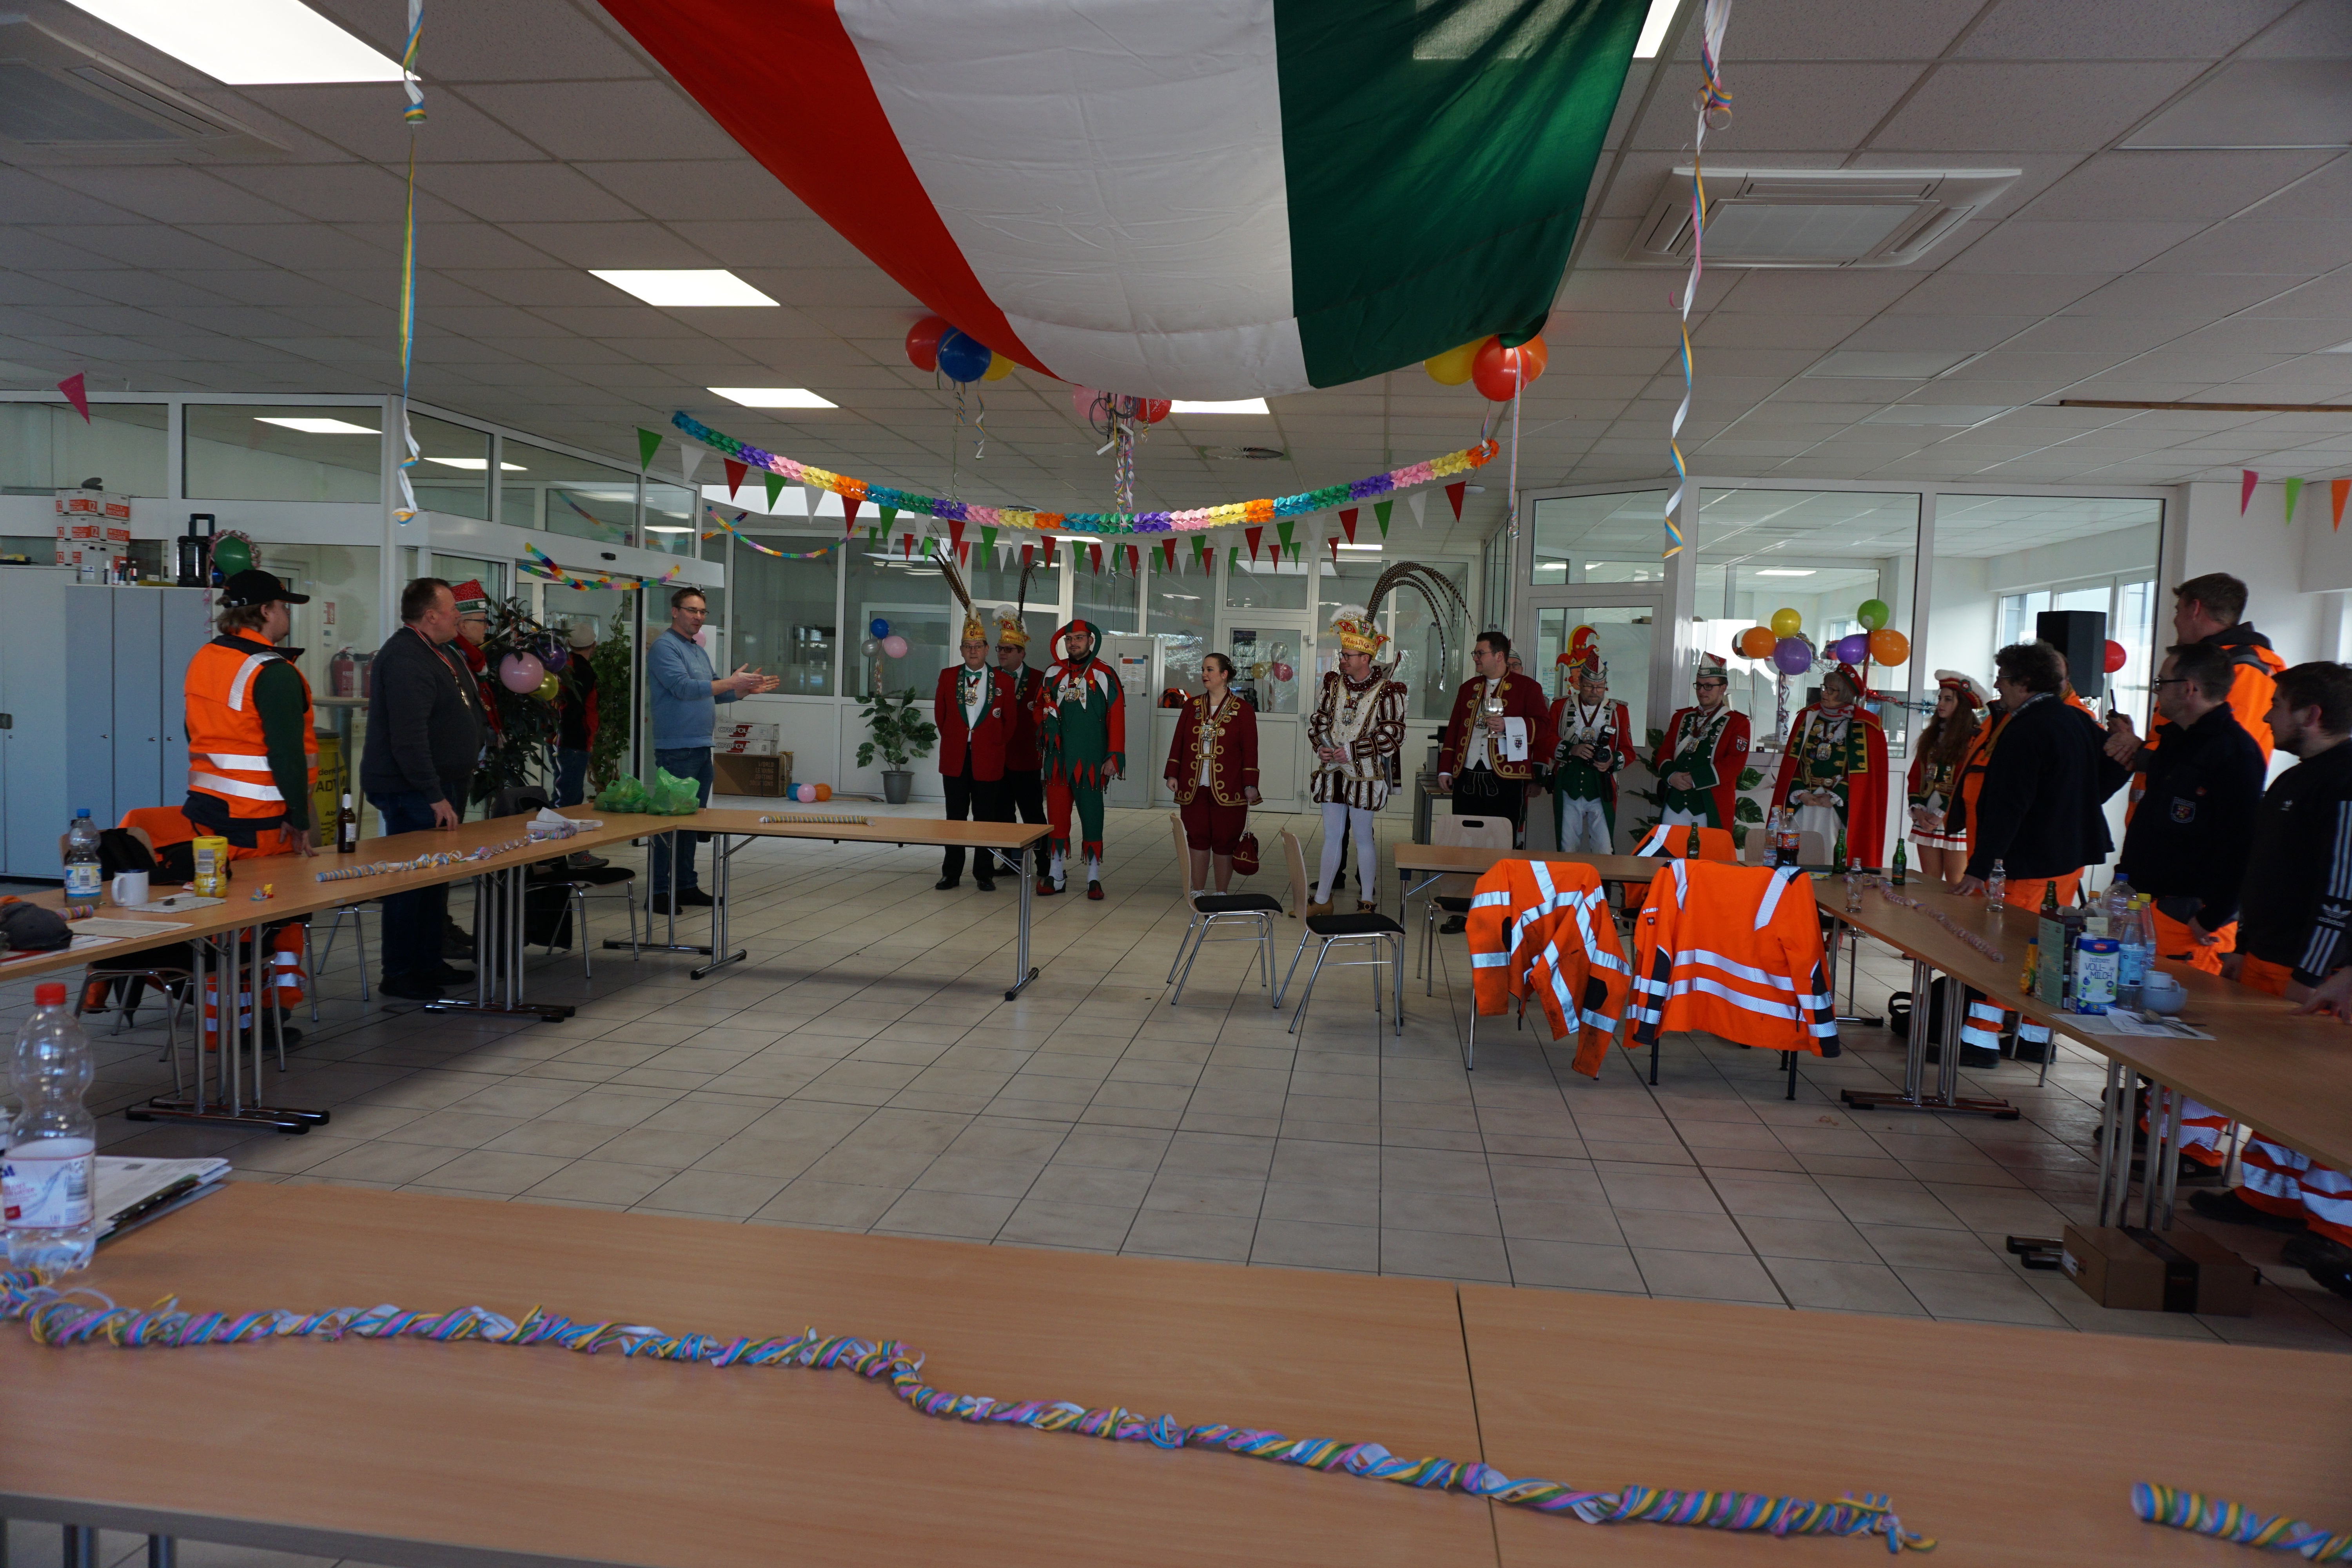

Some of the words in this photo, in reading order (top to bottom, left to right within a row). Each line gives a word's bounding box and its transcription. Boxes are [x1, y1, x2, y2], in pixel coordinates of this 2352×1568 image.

[89, 501, 97, 511] 12
[91, 527, 98, 537] 12
[2085, 963, 2106, 971] VOLL-
[2090, 971, 2112, 980] MILCH
